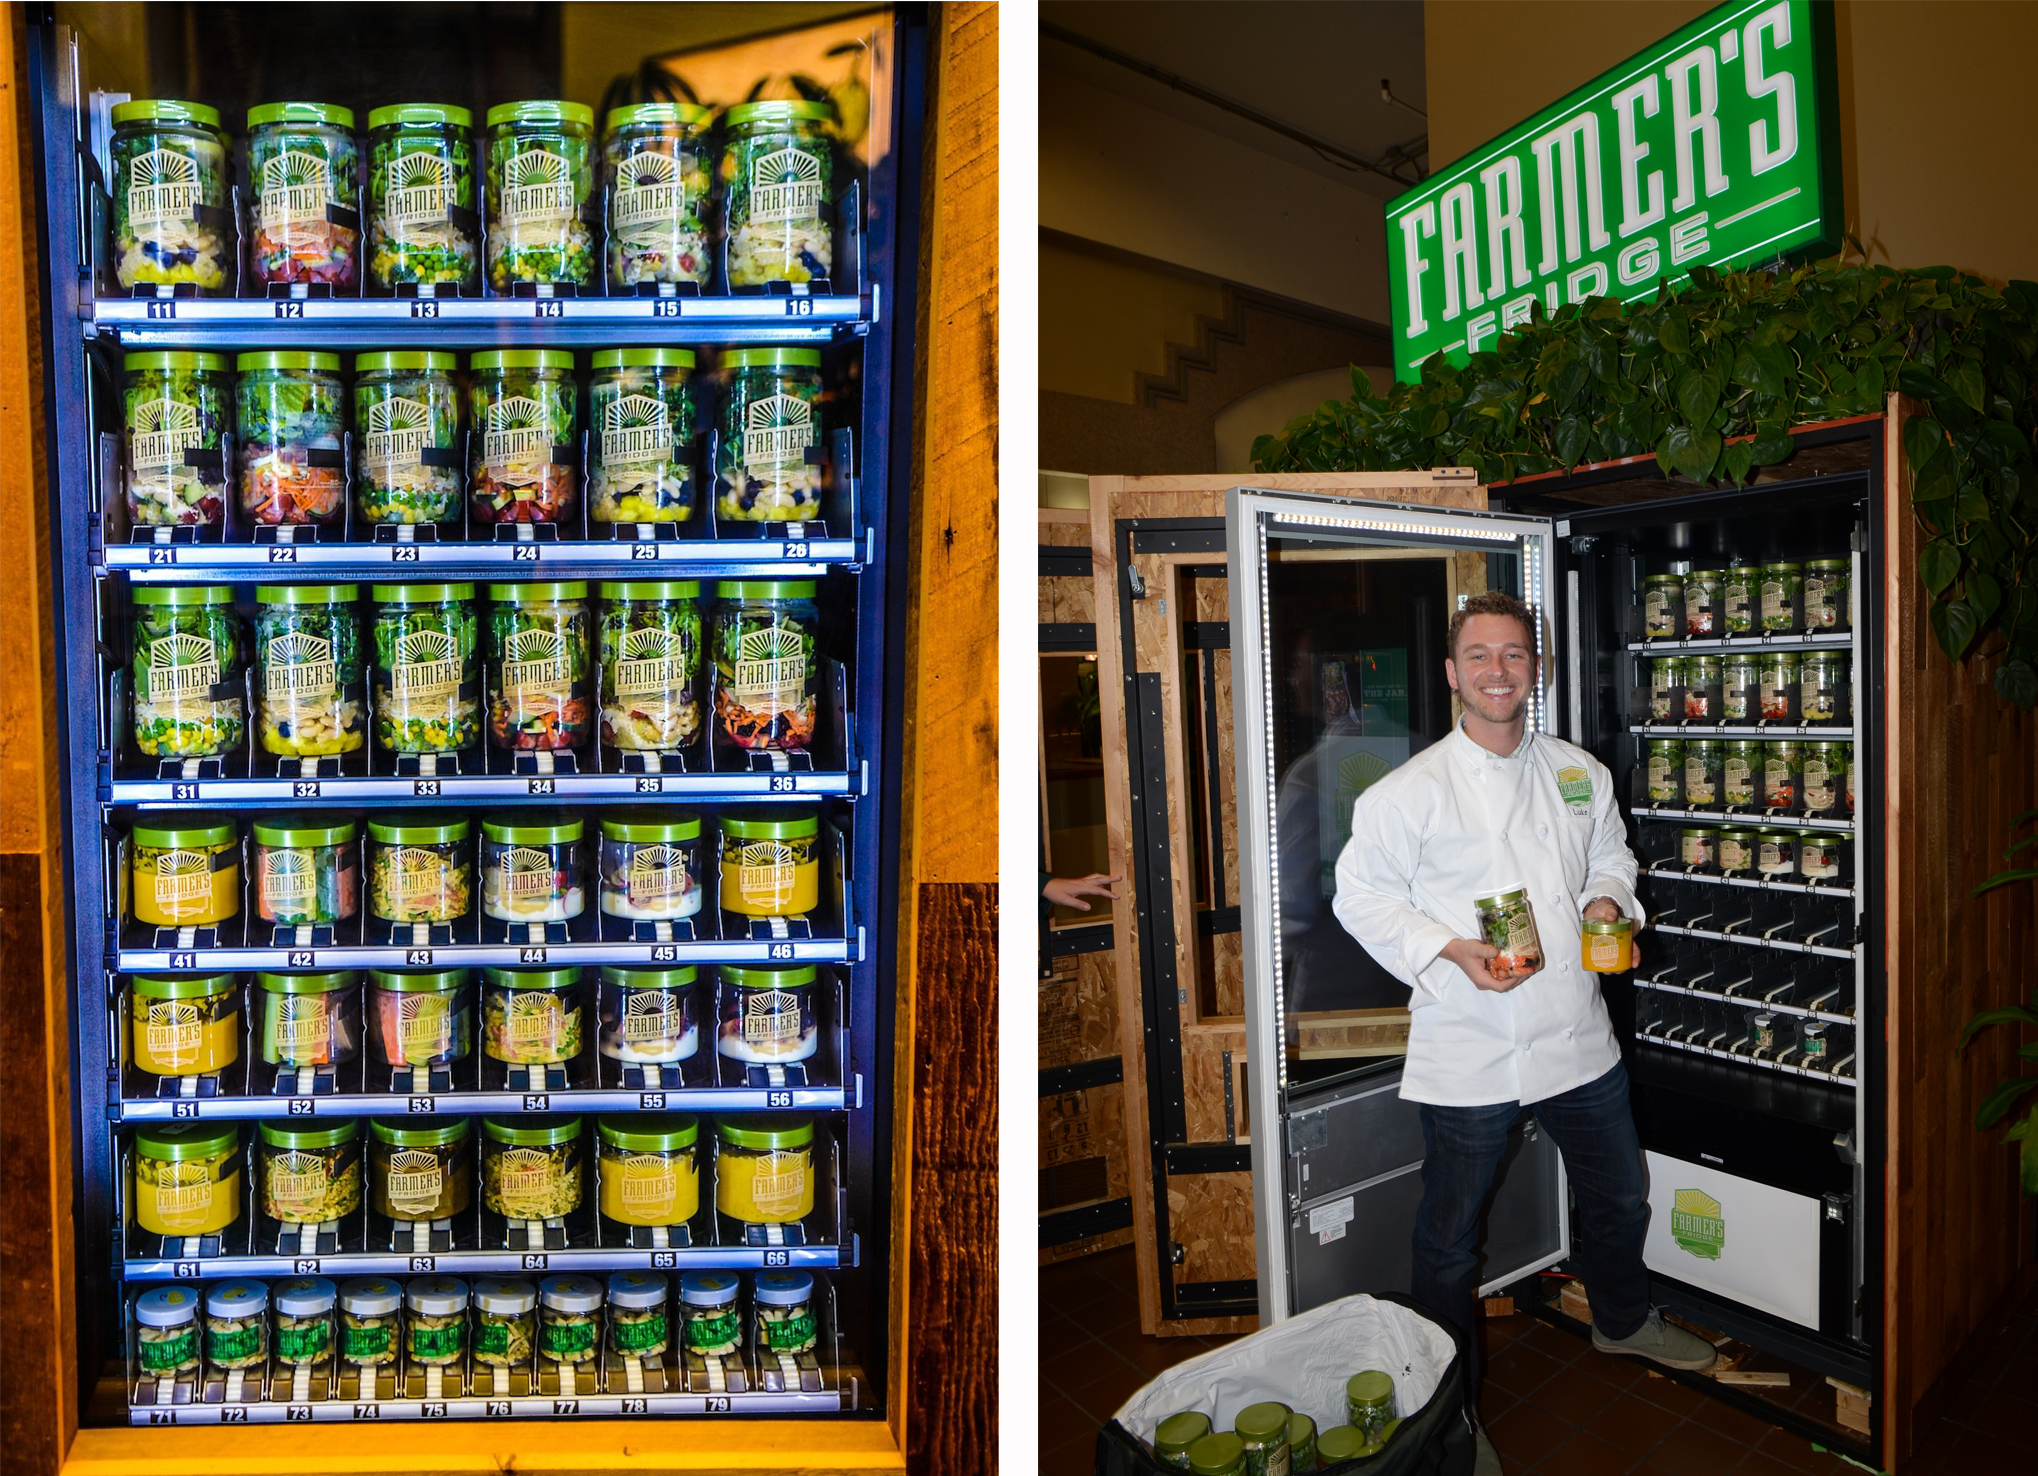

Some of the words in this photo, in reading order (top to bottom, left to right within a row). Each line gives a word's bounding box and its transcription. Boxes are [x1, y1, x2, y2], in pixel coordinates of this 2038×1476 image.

[1399, 0, 1799, 339] FARMER'S
[131, 185, 201, 212] FARMER'S
[388, 188, 455, 215] FARMER'S
[616, 185, 683, 213] FARMER'S
[754, 184, 821, 213] FARMER'S
[626, 209, 670, 220] FRIDGE
[1465, 210, 1709, 354] FRIDGE
[152, 303, 171, 317] 11
[279, 303, 300, 317] 12
[415, 303, 435, 317] 13
[540, 303, 559, 316] 14
[658, 302, 677, 315] 15
[790, 300, 810, 314] 16
[135, 430, 200, 459] FARMER'S
[368, 431, 434, 458] FARMER'S
[604, 427, 670, 457] FARMER'S
[614, 450, 657, 459] FRIDGE
[154, 549, 172, 562] 21
[272, 549, 293, 562] 22
[395, 547, 416, 560] 23
[517, 546, 537, 560] 24
[636, 545, 656, 558] 25
[786, 543, 807, 557] 26
[150, 664, 218, 691] FARMER'S
[268, 663, 334, 689] FARMER'S
[505, 659, 570, 686] FARMER'S
[618, 658, 684, 686] FARMER'S
[278, 686, 320, 697] FRDGE
[1385, 689, 1408, 697] JAR.
[297, 783, 317, 796] 32
[418, 781, 438, 795] 33
[532, 779, 551, 793] 34
[640, 778, 660, 792] 35
[773, 777, 793, 790] 36
[177, 785, 196, 799] 31
[157, 874, 210, 894] FARMER'S
[410, 951, 430, 964] 43
[523, 949, 543, 962] 44
[655, 948, 674, 960] 45
[772, 945, 791, 958] 46
[174, 954, 192, 967] 41
[292, 953, 311, 965] 42
[627, 1013, 679, 1032] FARMER'S
[412, 1099, 431, 1112] 53
[526, 1097, 546, 1109] 54
[644, 1094, 663, 1107] 55
[770, 1093, 790, 1106] 56
[177, 1104, 195, 1116] 51
[292, 1100, 311, 1113] 52
[1047, 1149, 1059, 1161] 13
[274, 1174, 325, 1193] FARMER'S
[391, 1172, 440, 1192] FARMER'S
[502, 1171, 552, 1188] FARMER'S
[624, 1177, 675, 1195] FARMER'S
[755, 1174, 803, 1194] FARMER'S
[158, 1184, 211, 1206] FARMER'S
[398, 1188, 431, 1196] FRIDGE
[1673, 1213, 1723, 1238] FARMER'S
[413, 1258, 432, 1270] 63
[525, 1256, 544, 1268] 64
[655, 1254, 674, 1266] 65
[767, 1252, 786, 1264] 66
[178, 1264, 196, 1276] 61
[298, 1261, 317, 1273] 62
[425, 1405, 444, 1416] 75
[490, 1403, 509, 1414] 76
[557, 1402, 576, 1413] 77
[625, 1400, 643, 1412] 78
[708, 1398, 728, 1410] 79
[155, 1411, 172, 1423] 71
[224, 1409, 244, 1420] 72
[290, 1407, 309, 1419] 73
[357, 1406, 376, 1417] 74
